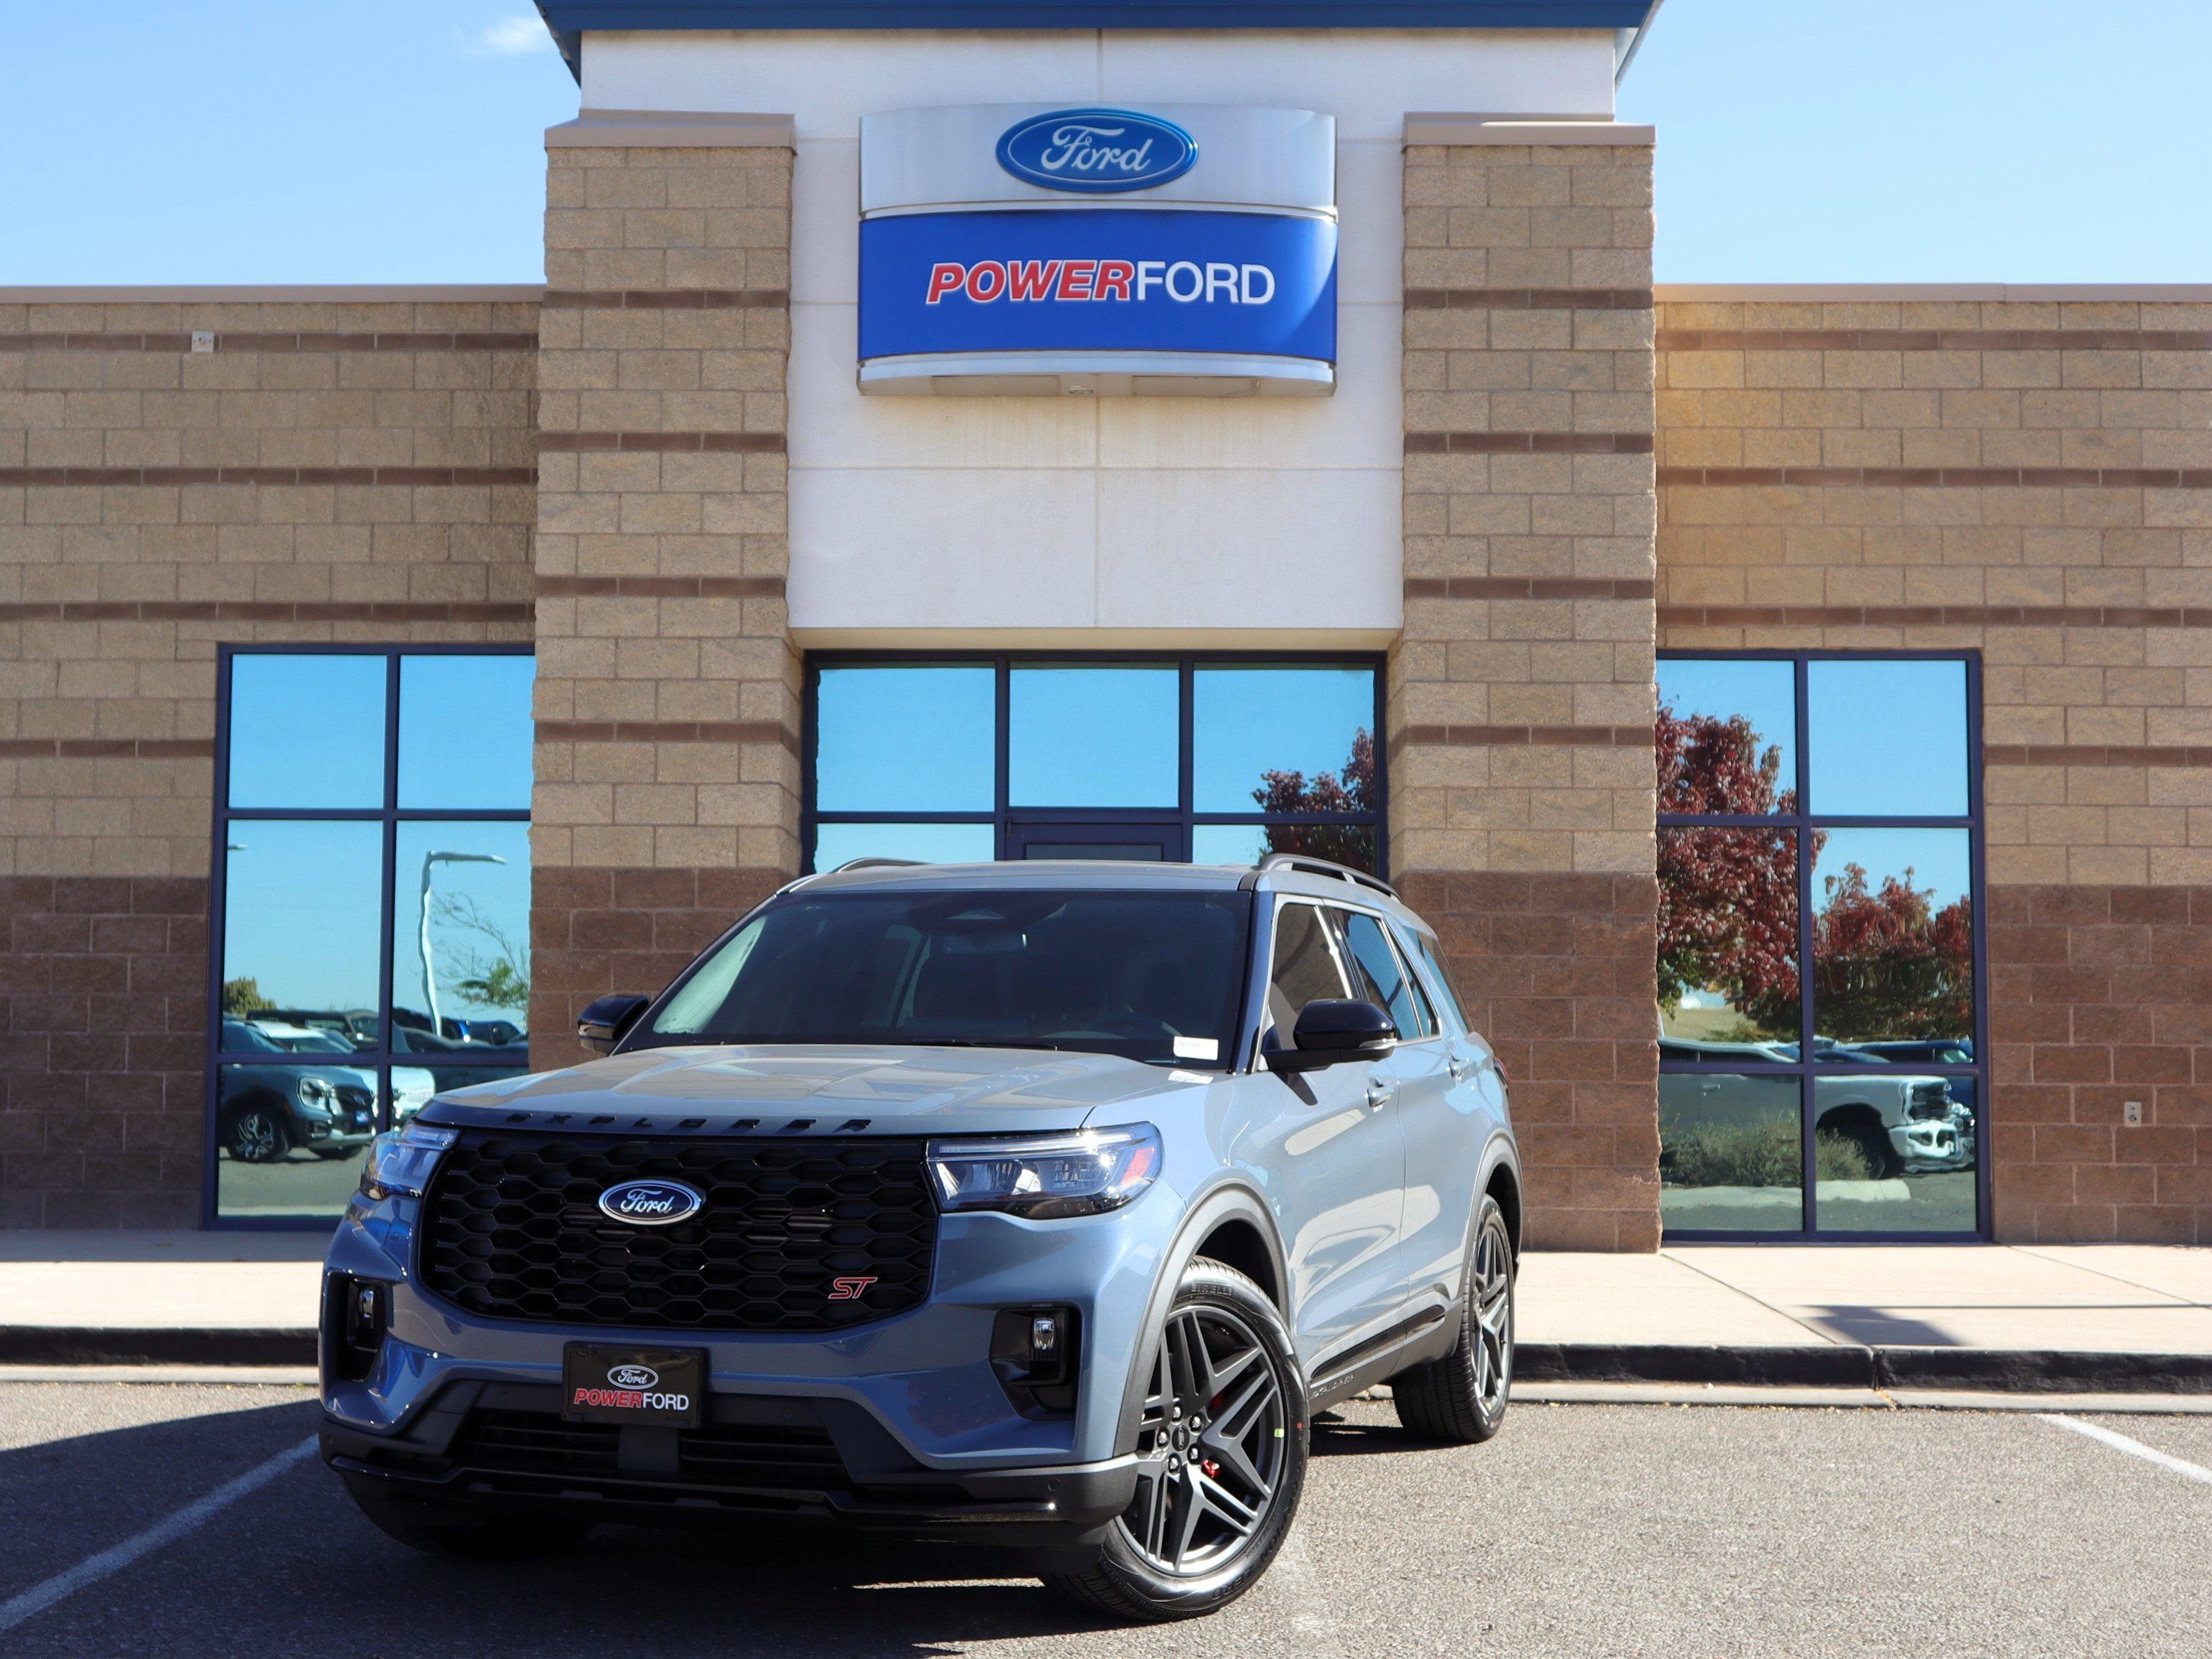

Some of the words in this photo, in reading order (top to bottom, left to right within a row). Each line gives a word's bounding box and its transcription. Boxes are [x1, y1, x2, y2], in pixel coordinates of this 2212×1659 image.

[1041, 125, 1153, 171] Ford
[926, 260, 1275, 305] POWERFORD
[505, 1113, 872, 1130] EXPLORER
[620, 1188, 675, 1214] Ford
[828, 1277, 878, 1300] ST
[617, 1369, 648, 1385] Ford
[573, 1388, 690, 1411] POWERFORD
